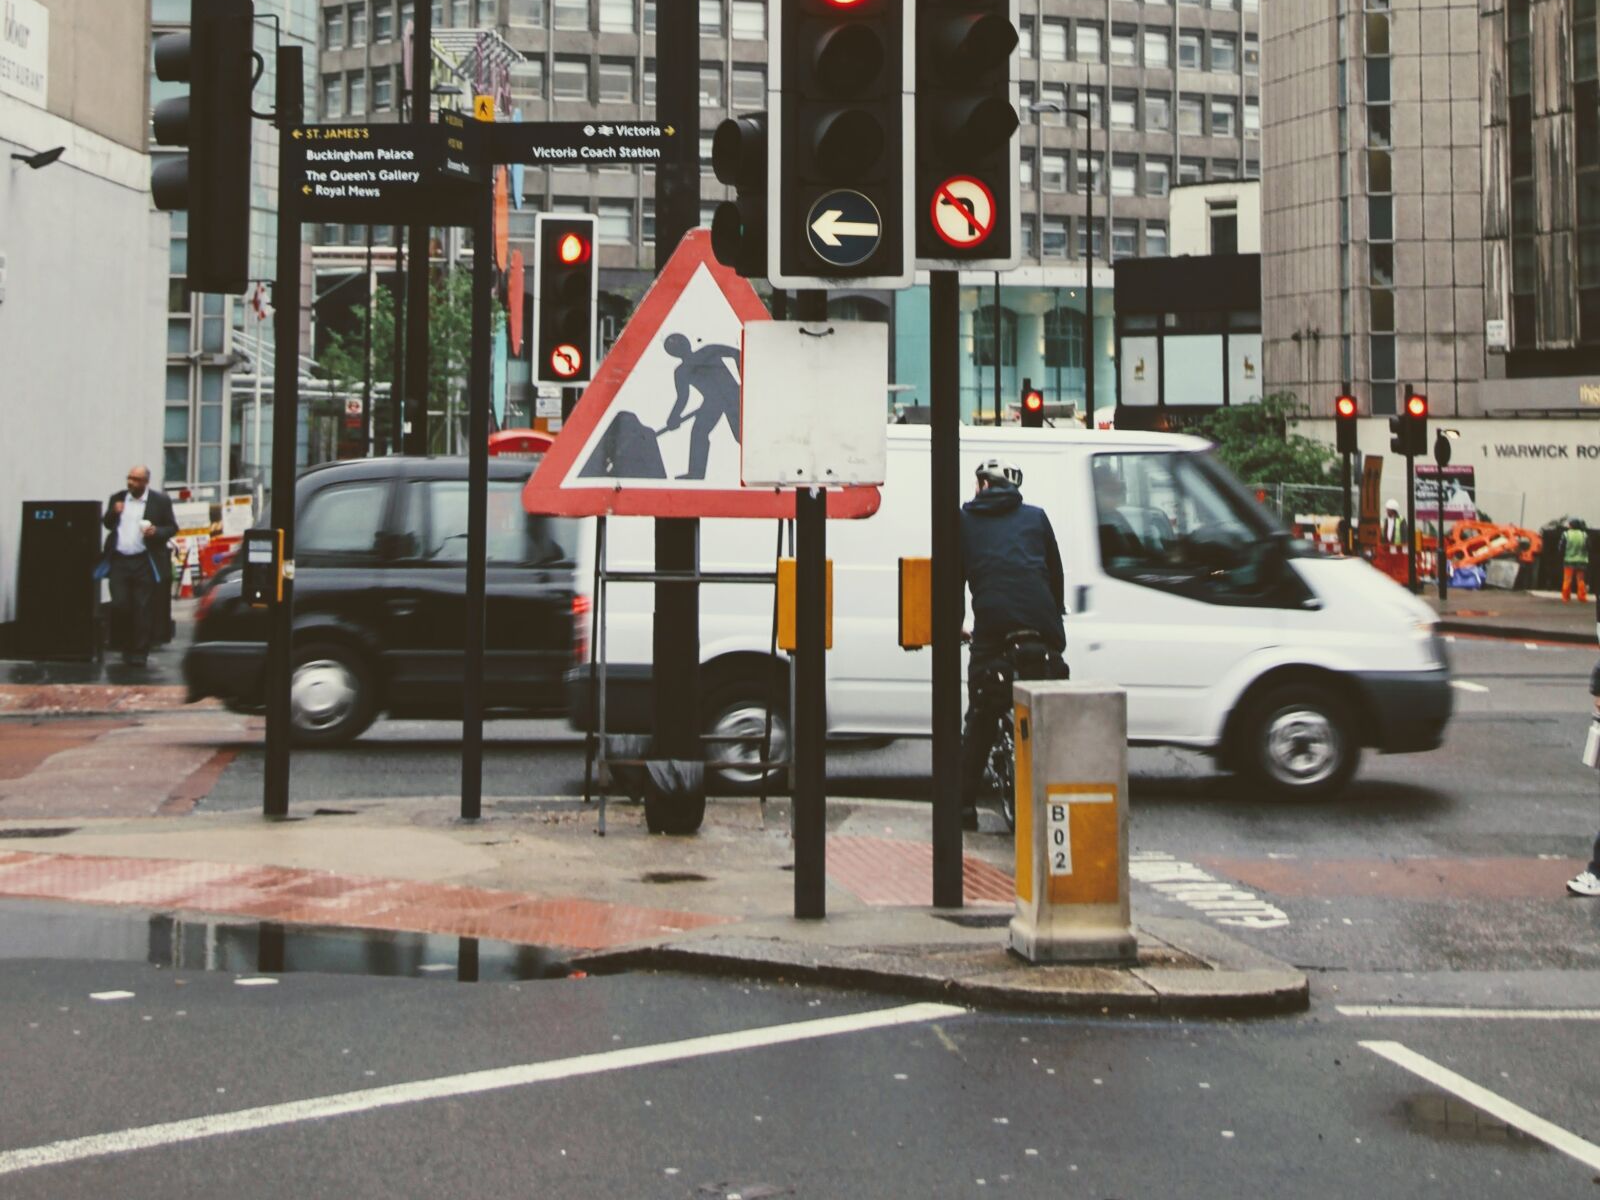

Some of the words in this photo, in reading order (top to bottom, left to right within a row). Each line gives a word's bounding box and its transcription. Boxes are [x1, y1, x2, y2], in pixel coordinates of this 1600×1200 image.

[0, 55, 44, 93] ESTAURANT
[305, 128, 321, 139] ST.
[324, 128, 369, 139] JAMES'S
[615, 125, 661, 136] Victoria
[306, 149, 375, 162] Buckingham
[377, 149, 414, 160] Palace
[532, 146, 578, 158] Victoria
[580, 146, 616, 158] Coach
[619, 146, 661, 158] Station
[305, 170, 328, 181] The
[330, 170, 376, 181] Queen's
[378, 169, 420, 183] Gallery
[315, 184, 346, 198] Royal
[348, 185, 381, 197] Mews
[1482, 444, 1488, 458] 1
[1494, 444, 1569, 459] WARWICK
[1576, 444, 1600, 459] RO
